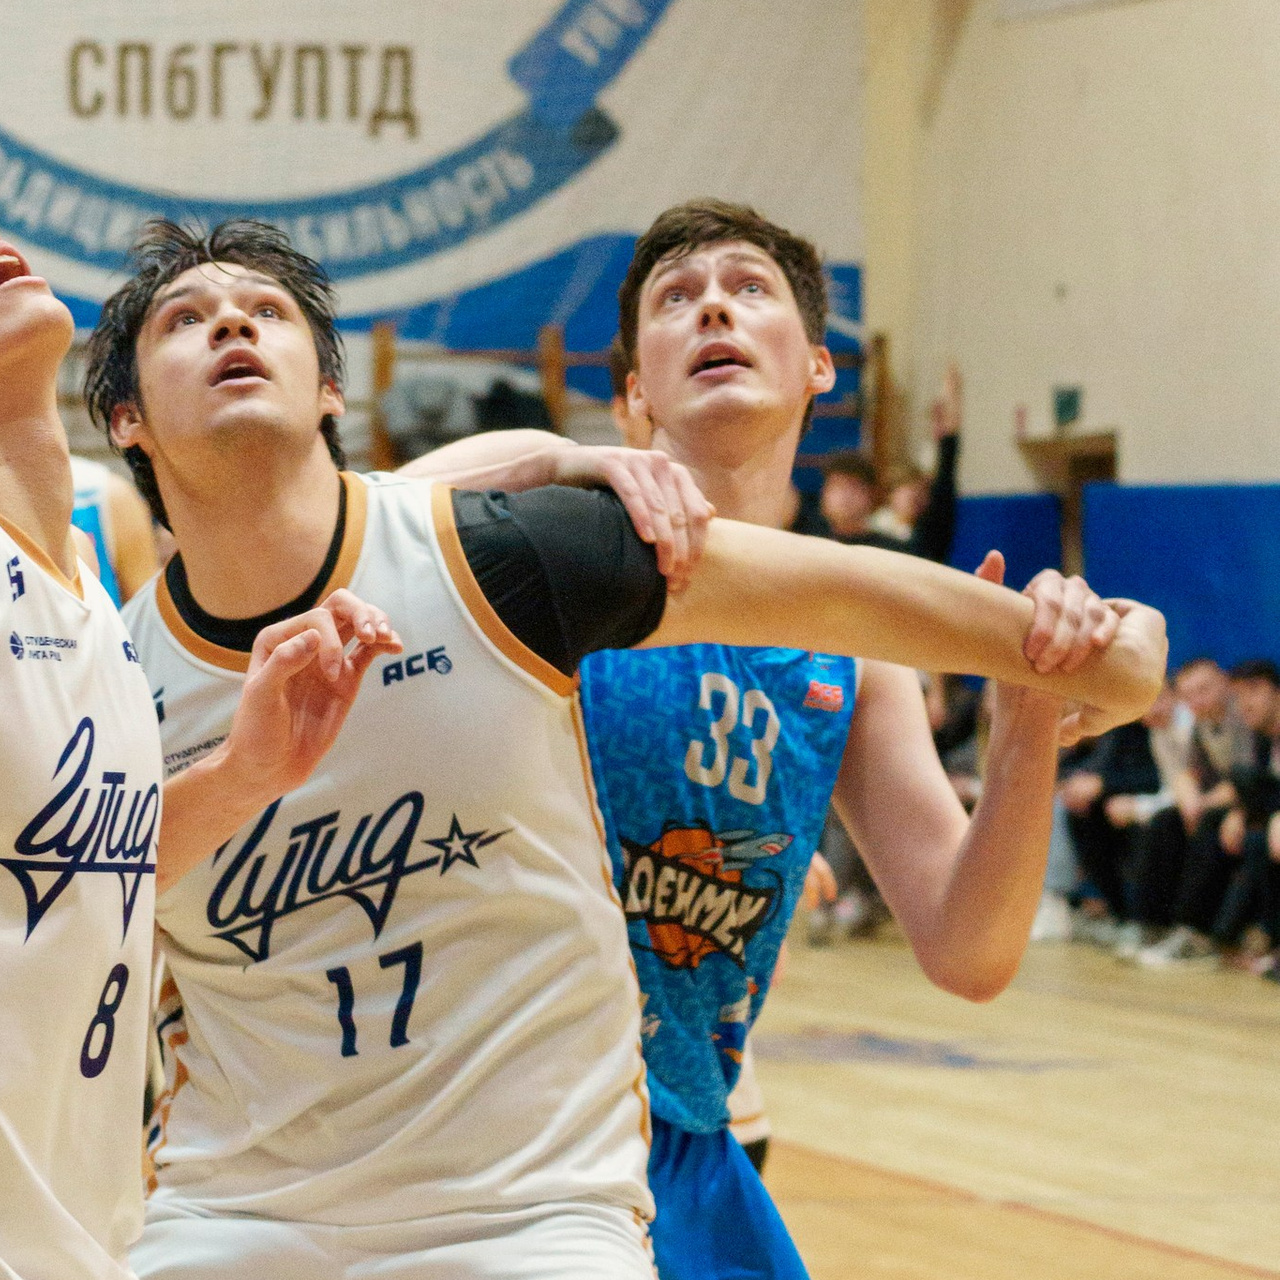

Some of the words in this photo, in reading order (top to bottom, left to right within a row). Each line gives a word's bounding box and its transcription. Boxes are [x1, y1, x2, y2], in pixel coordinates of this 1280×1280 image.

[683, 671, 781, 806] 33
[620, 846, 767, 960] ОЕНМЕХ
[79, 962, 130, 1078] 8
[325, 941, 425, 1058] 17
